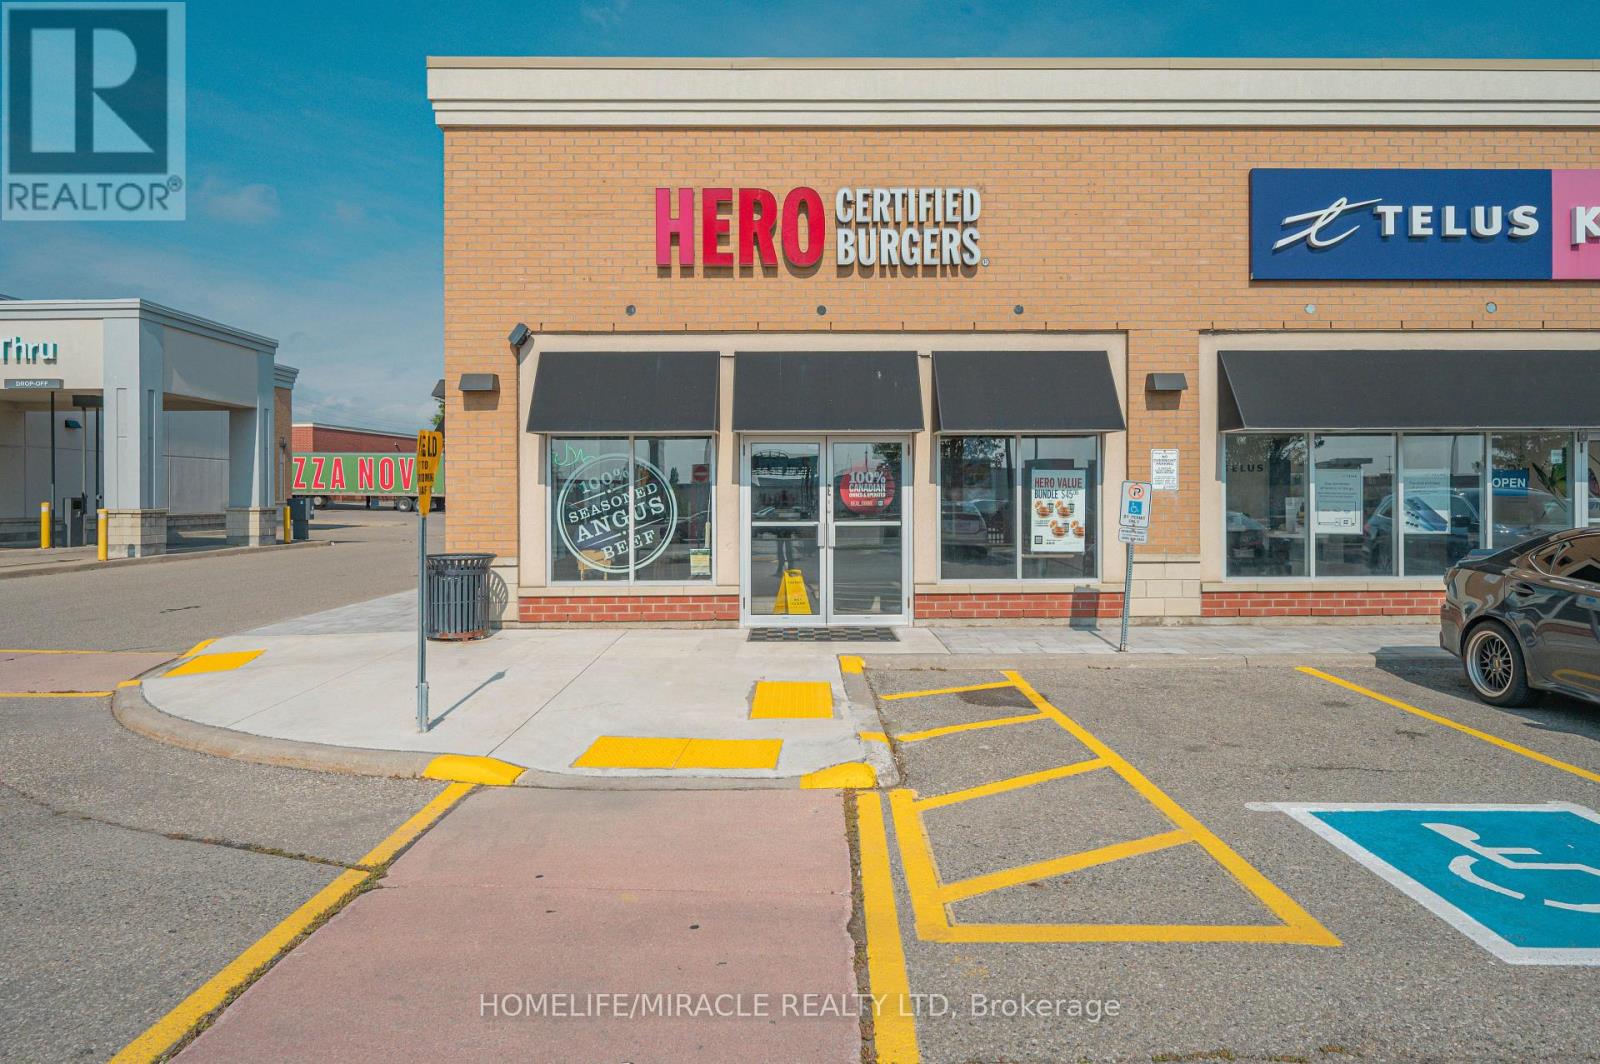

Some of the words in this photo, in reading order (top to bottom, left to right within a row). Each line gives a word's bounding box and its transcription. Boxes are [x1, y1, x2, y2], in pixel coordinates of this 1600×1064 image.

[835, 187, 982, 224] CERTIFIED
[655, 186, 826, 267] HERO
[1372, 205, 1539, 237] TELUS
[15, 380, 49, 388] DROP-OFF
[421, 461, 429, 470] TO
[849, 471, 886, 484] 100%
[1034, 477, 1055, 489] HERO
[1058, 477, 1083, 489] VALUE
[1492, 477, 1526, 488] OPEN
[848, 483, 886, 493] CANADIAN
[1034, 489, 1058, 499] BUNDLE
[568, 483, 658, 524] SEASONED
[576, 496, 665, 543] ANGUS
[601, 529, 655, 560] BEEF
